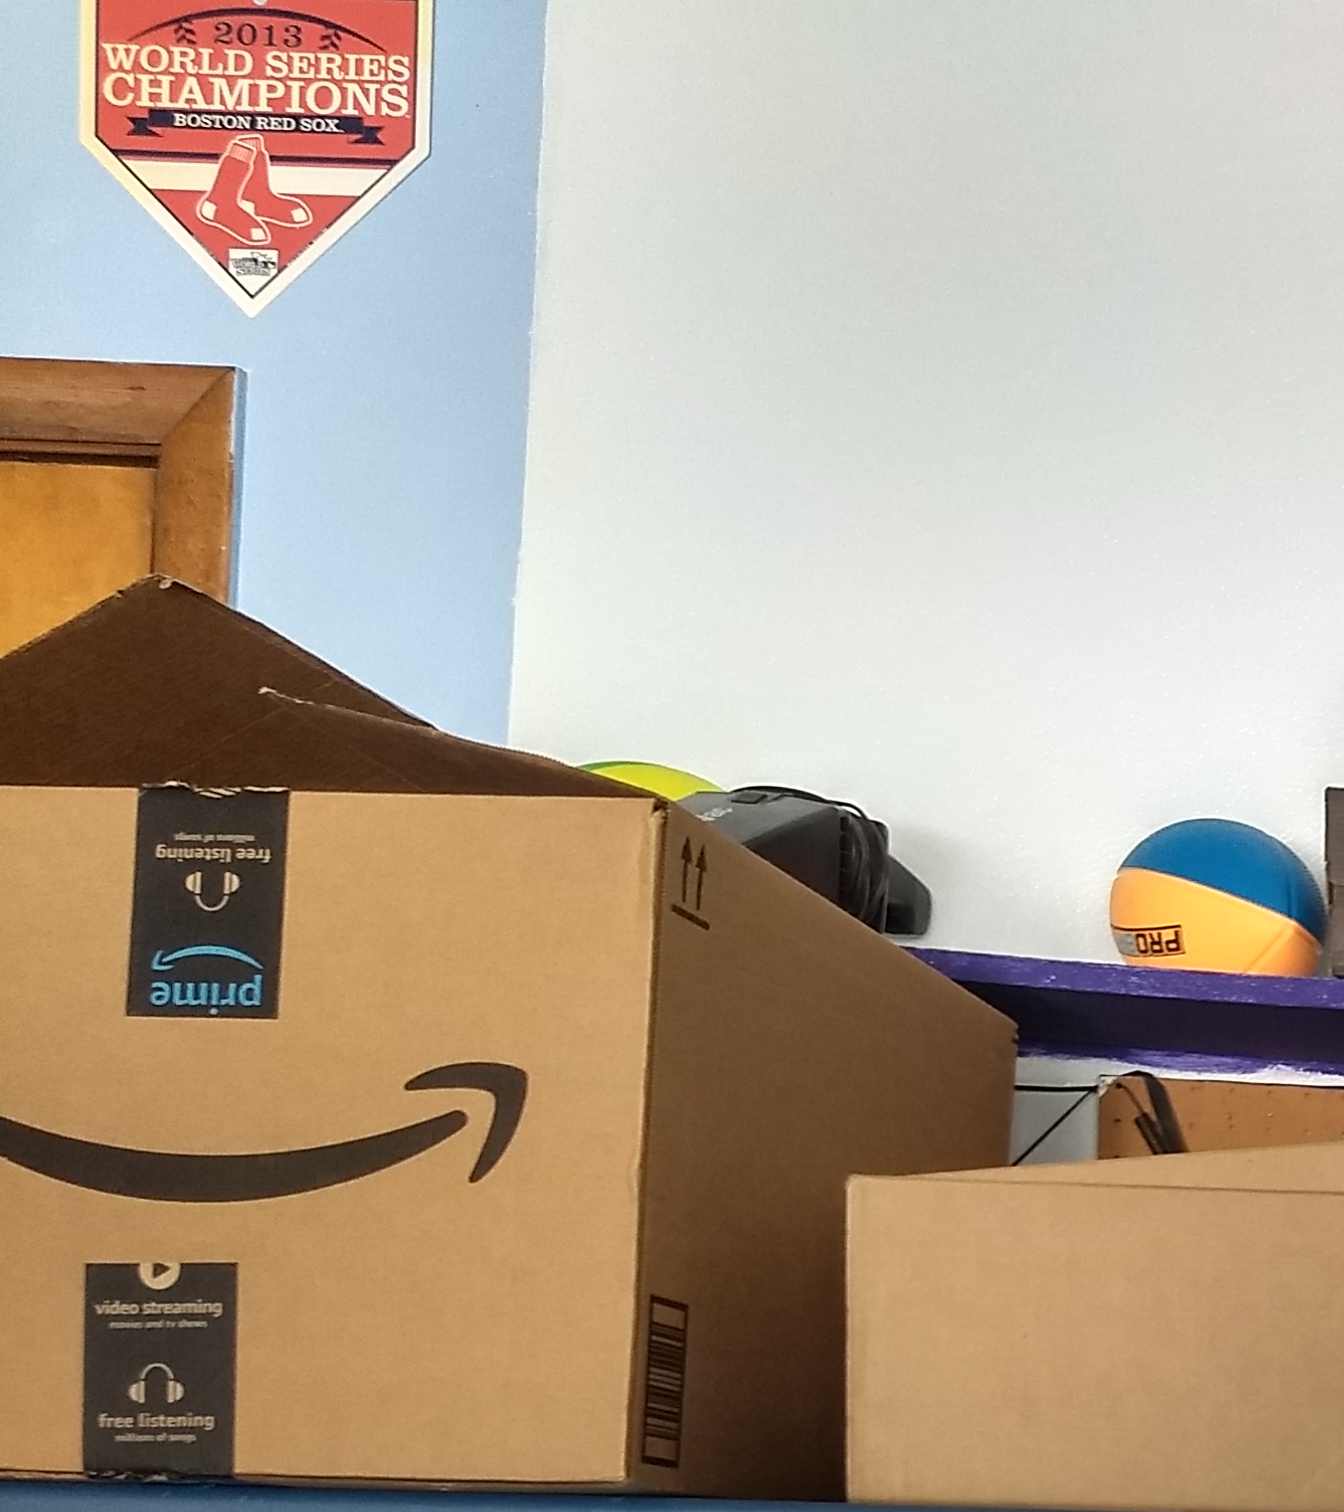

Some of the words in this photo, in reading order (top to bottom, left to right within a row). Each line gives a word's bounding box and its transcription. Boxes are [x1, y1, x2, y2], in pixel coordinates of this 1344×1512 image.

[214, 22, 303, 47] 2013
[101, 43, 253, 77] WORLD
[265, 51, 411, 82] SERIES
[102, 72, 411, 118] CHAMPIONS
[173, 113, 253, 131] BOSTON
[256, 115, 296, 132] RED
[299, 117, 343, 134] SOX
[155, 844, 231, 863] listening
[235, 846, 272, 864] free
[1135, 929, 1182, 954] PRO
[150, 974, 263, 1016] prime
[95, 1300, 140, 1316] video
[141, 1299, 224, 1318] streaming
[97, 1412, 134, 1429] free
[137, 1412, 216, 1431] listening
